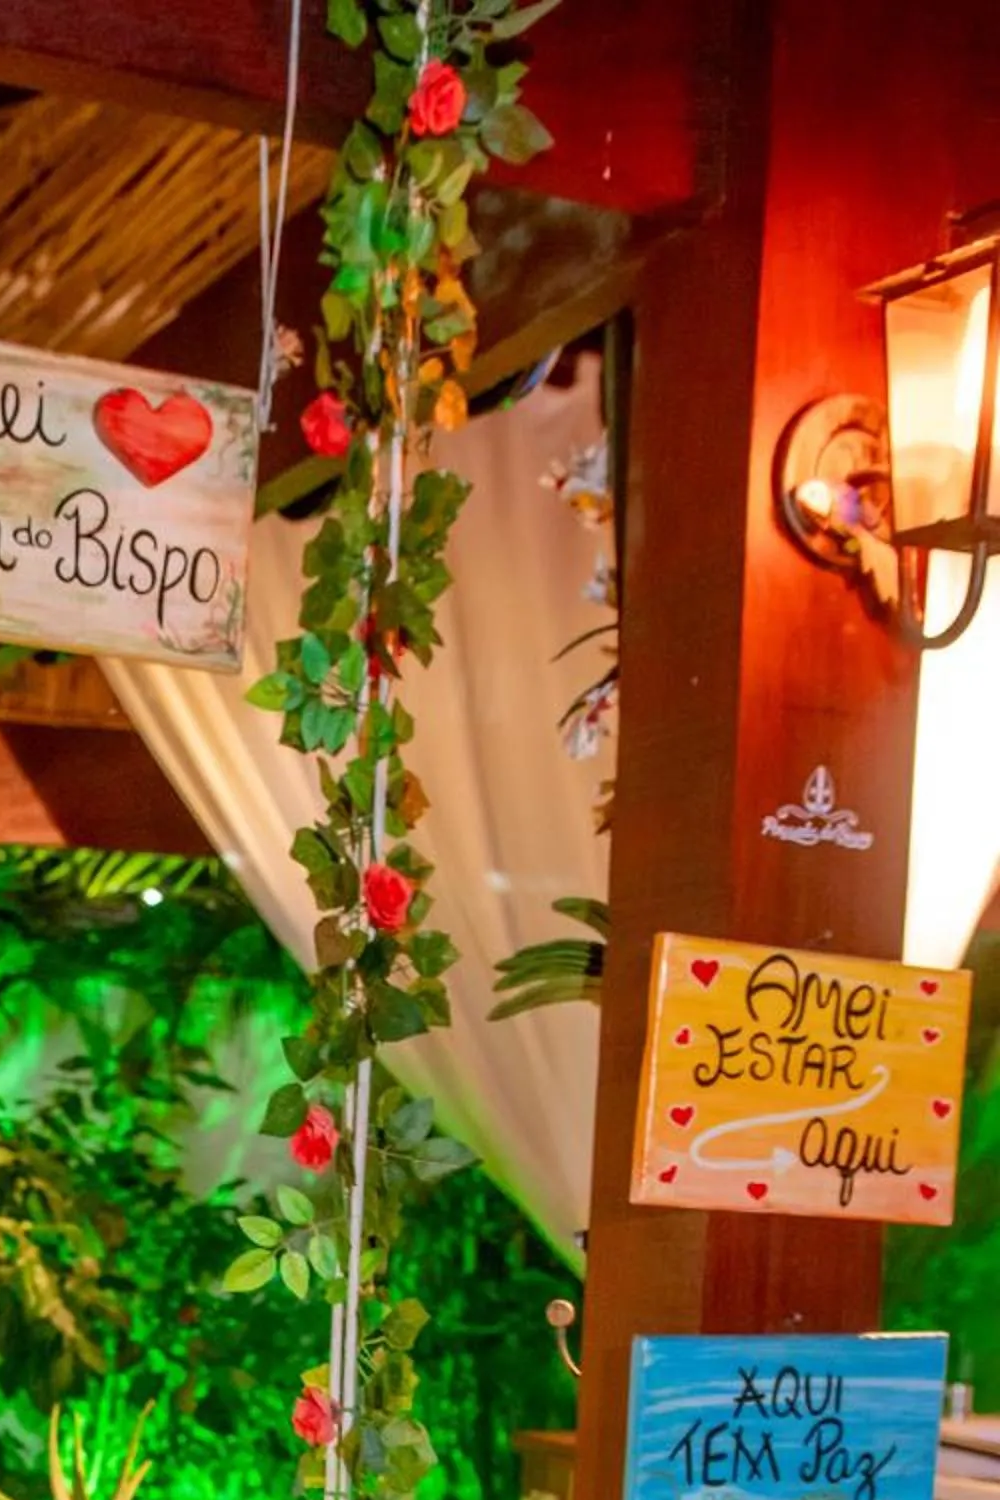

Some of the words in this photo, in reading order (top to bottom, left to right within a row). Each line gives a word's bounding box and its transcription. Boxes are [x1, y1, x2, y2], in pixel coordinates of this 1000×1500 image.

[12, 516, 53, 550] do
[54, 488, 220, 628] Bispo
[694, 1023, 864, 1090] ESTAR
[733, 1365, 843, 1420] AQUI
[667, 1418, 782, 1487] TEM
